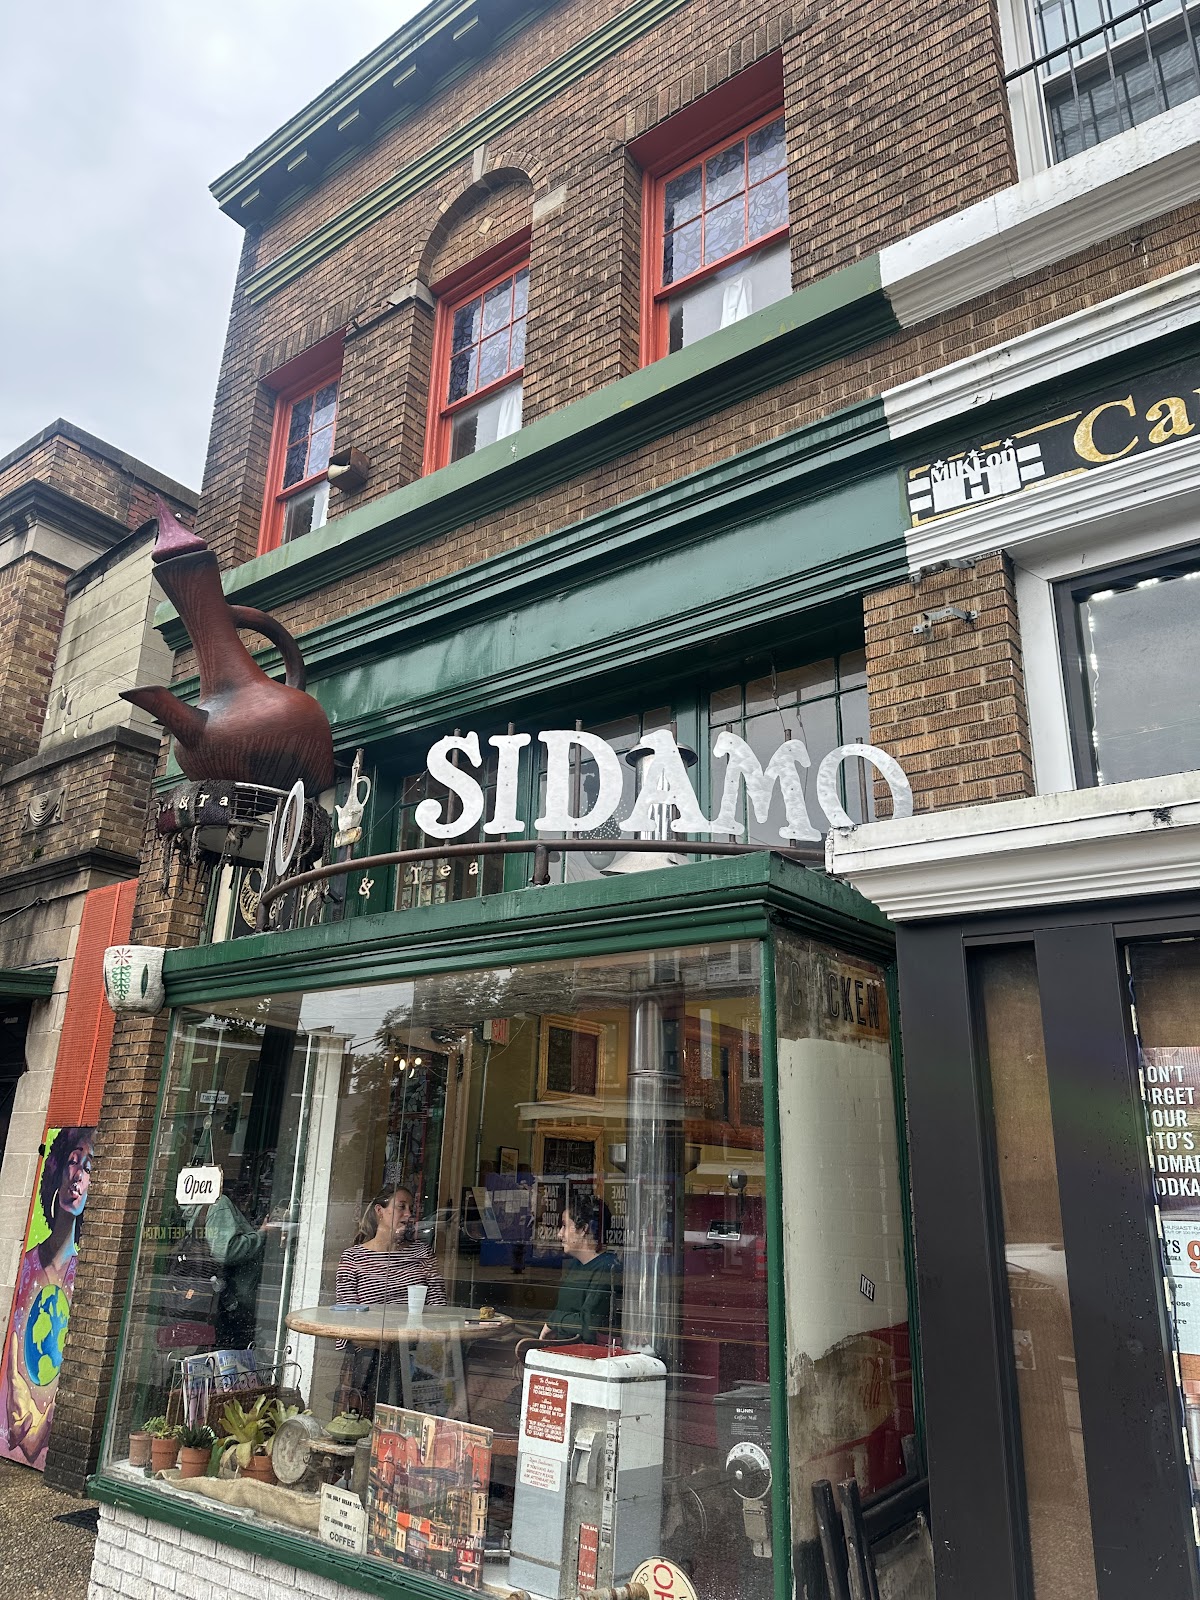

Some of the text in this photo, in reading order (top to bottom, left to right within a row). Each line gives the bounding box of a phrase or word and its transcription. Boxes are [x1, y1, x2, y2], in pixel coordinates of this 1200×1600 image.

[1073, 388, 1200, 463] Ca
[414, 728, 913, 842] SIDAMO
[410, 861, 479, 885] Tea
[1147, 1065, 1184, 1084] ON'T
[1148, 1087, 1195, 1105] RGET
[1152, 1110, 1188, 1128] OUR
[1153, 1131, 1195, 1150] TO'S
[183, 1174, 214, 1200] Open
[1155, 1177, 1200, 1197] ODKA
[329, 1531, 356, 1549] COFFEE
